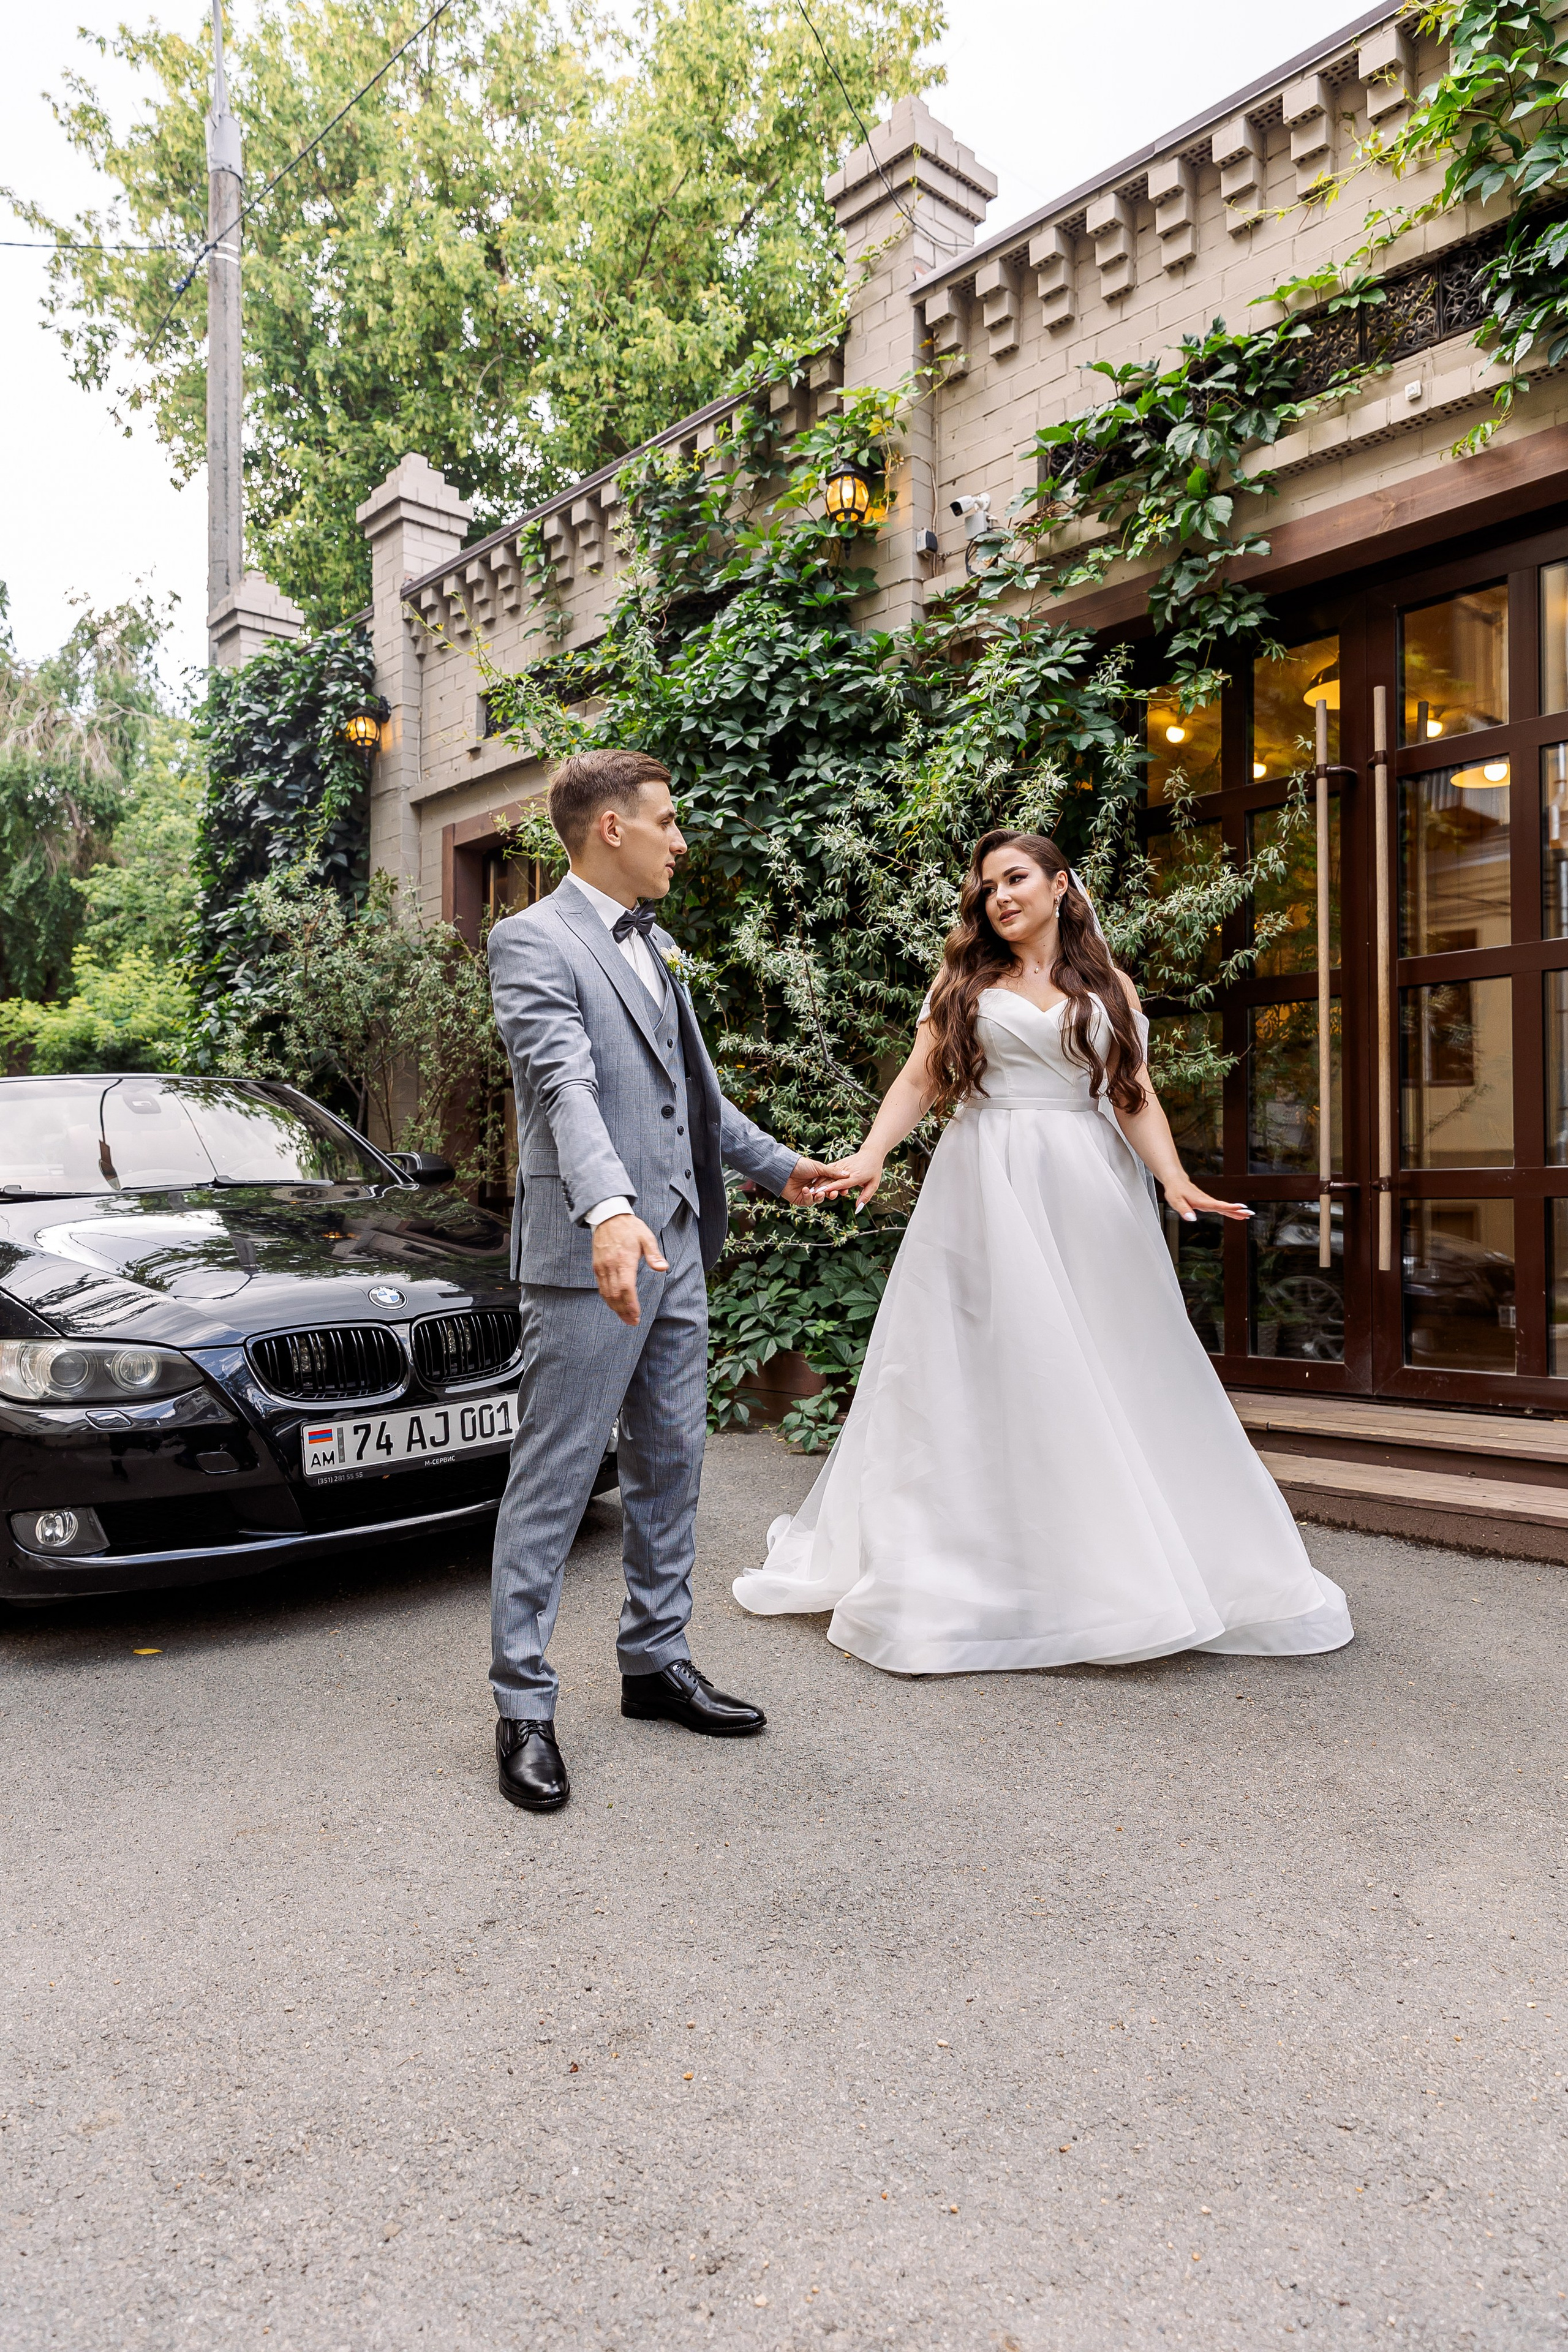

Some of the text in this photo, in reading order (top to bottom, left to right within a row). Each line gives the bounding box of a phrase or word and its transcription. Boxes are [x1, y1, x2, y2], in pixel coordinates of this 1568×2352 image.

[353, 1401, 513, 1461] 74 AJ 001
[311, 1450, 334, 1468] AM
[424, 1455, 455, 1466] М-СЕРВИС
[317, 1476, 333, 1485] (351)
